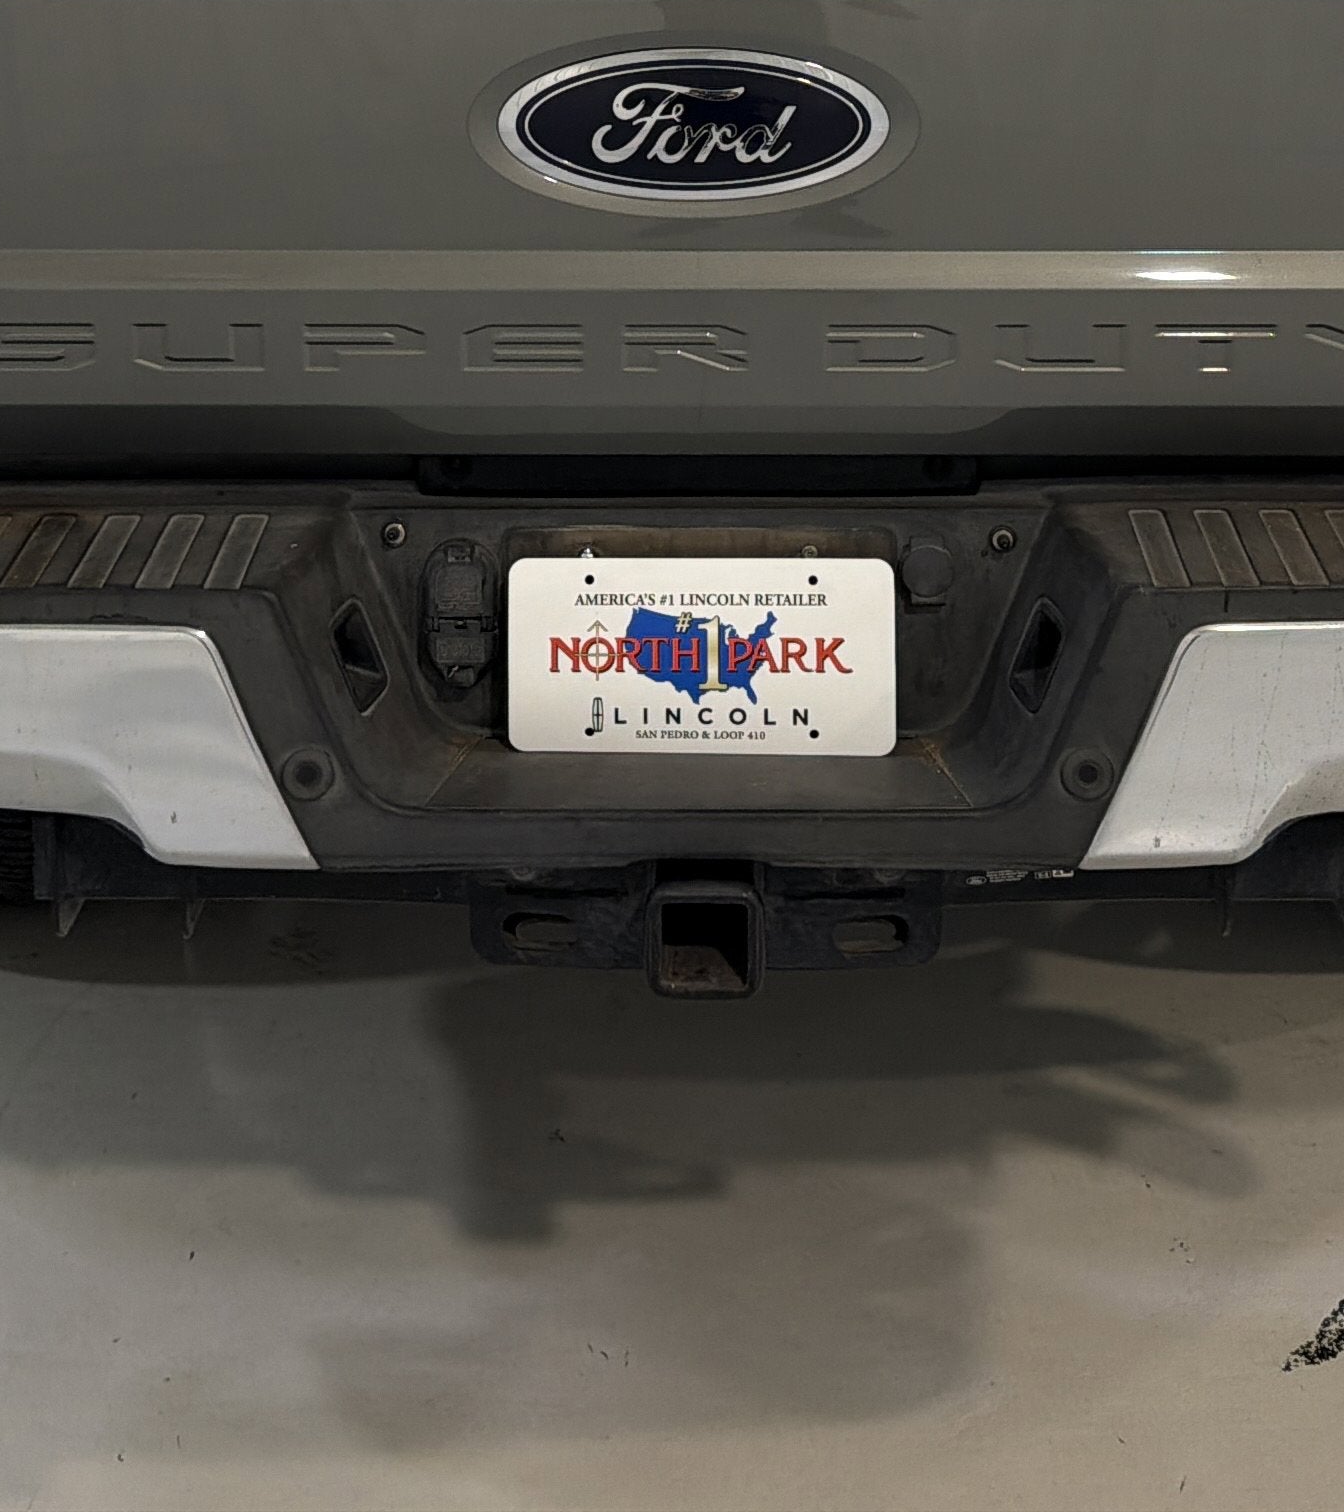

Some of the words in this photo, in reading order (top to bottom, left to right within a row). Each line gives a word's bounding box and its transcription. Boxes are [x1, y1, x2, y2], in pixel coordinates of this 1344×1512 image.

[590, 82, 797, 164] Ford
[574, 592, 656, 607] AMERICA'S
[659, 593, 675, 607] #1
[679, 593, 750, 607] LINCOLN
[754, 593, 827, 607] RETAILER
[549, 636, 700, 674] NORTH
[727, 636, 854, 674] PARK
[615, 707, 810, 726] LINCOLN
[635, 729, 657, 740] SAN
[660, 729, 699, 740] PEDRO
[702, 729, 710, 740] &
[713, 729, 744, 740] LOOP
[747, 729, 766, 740] 410
